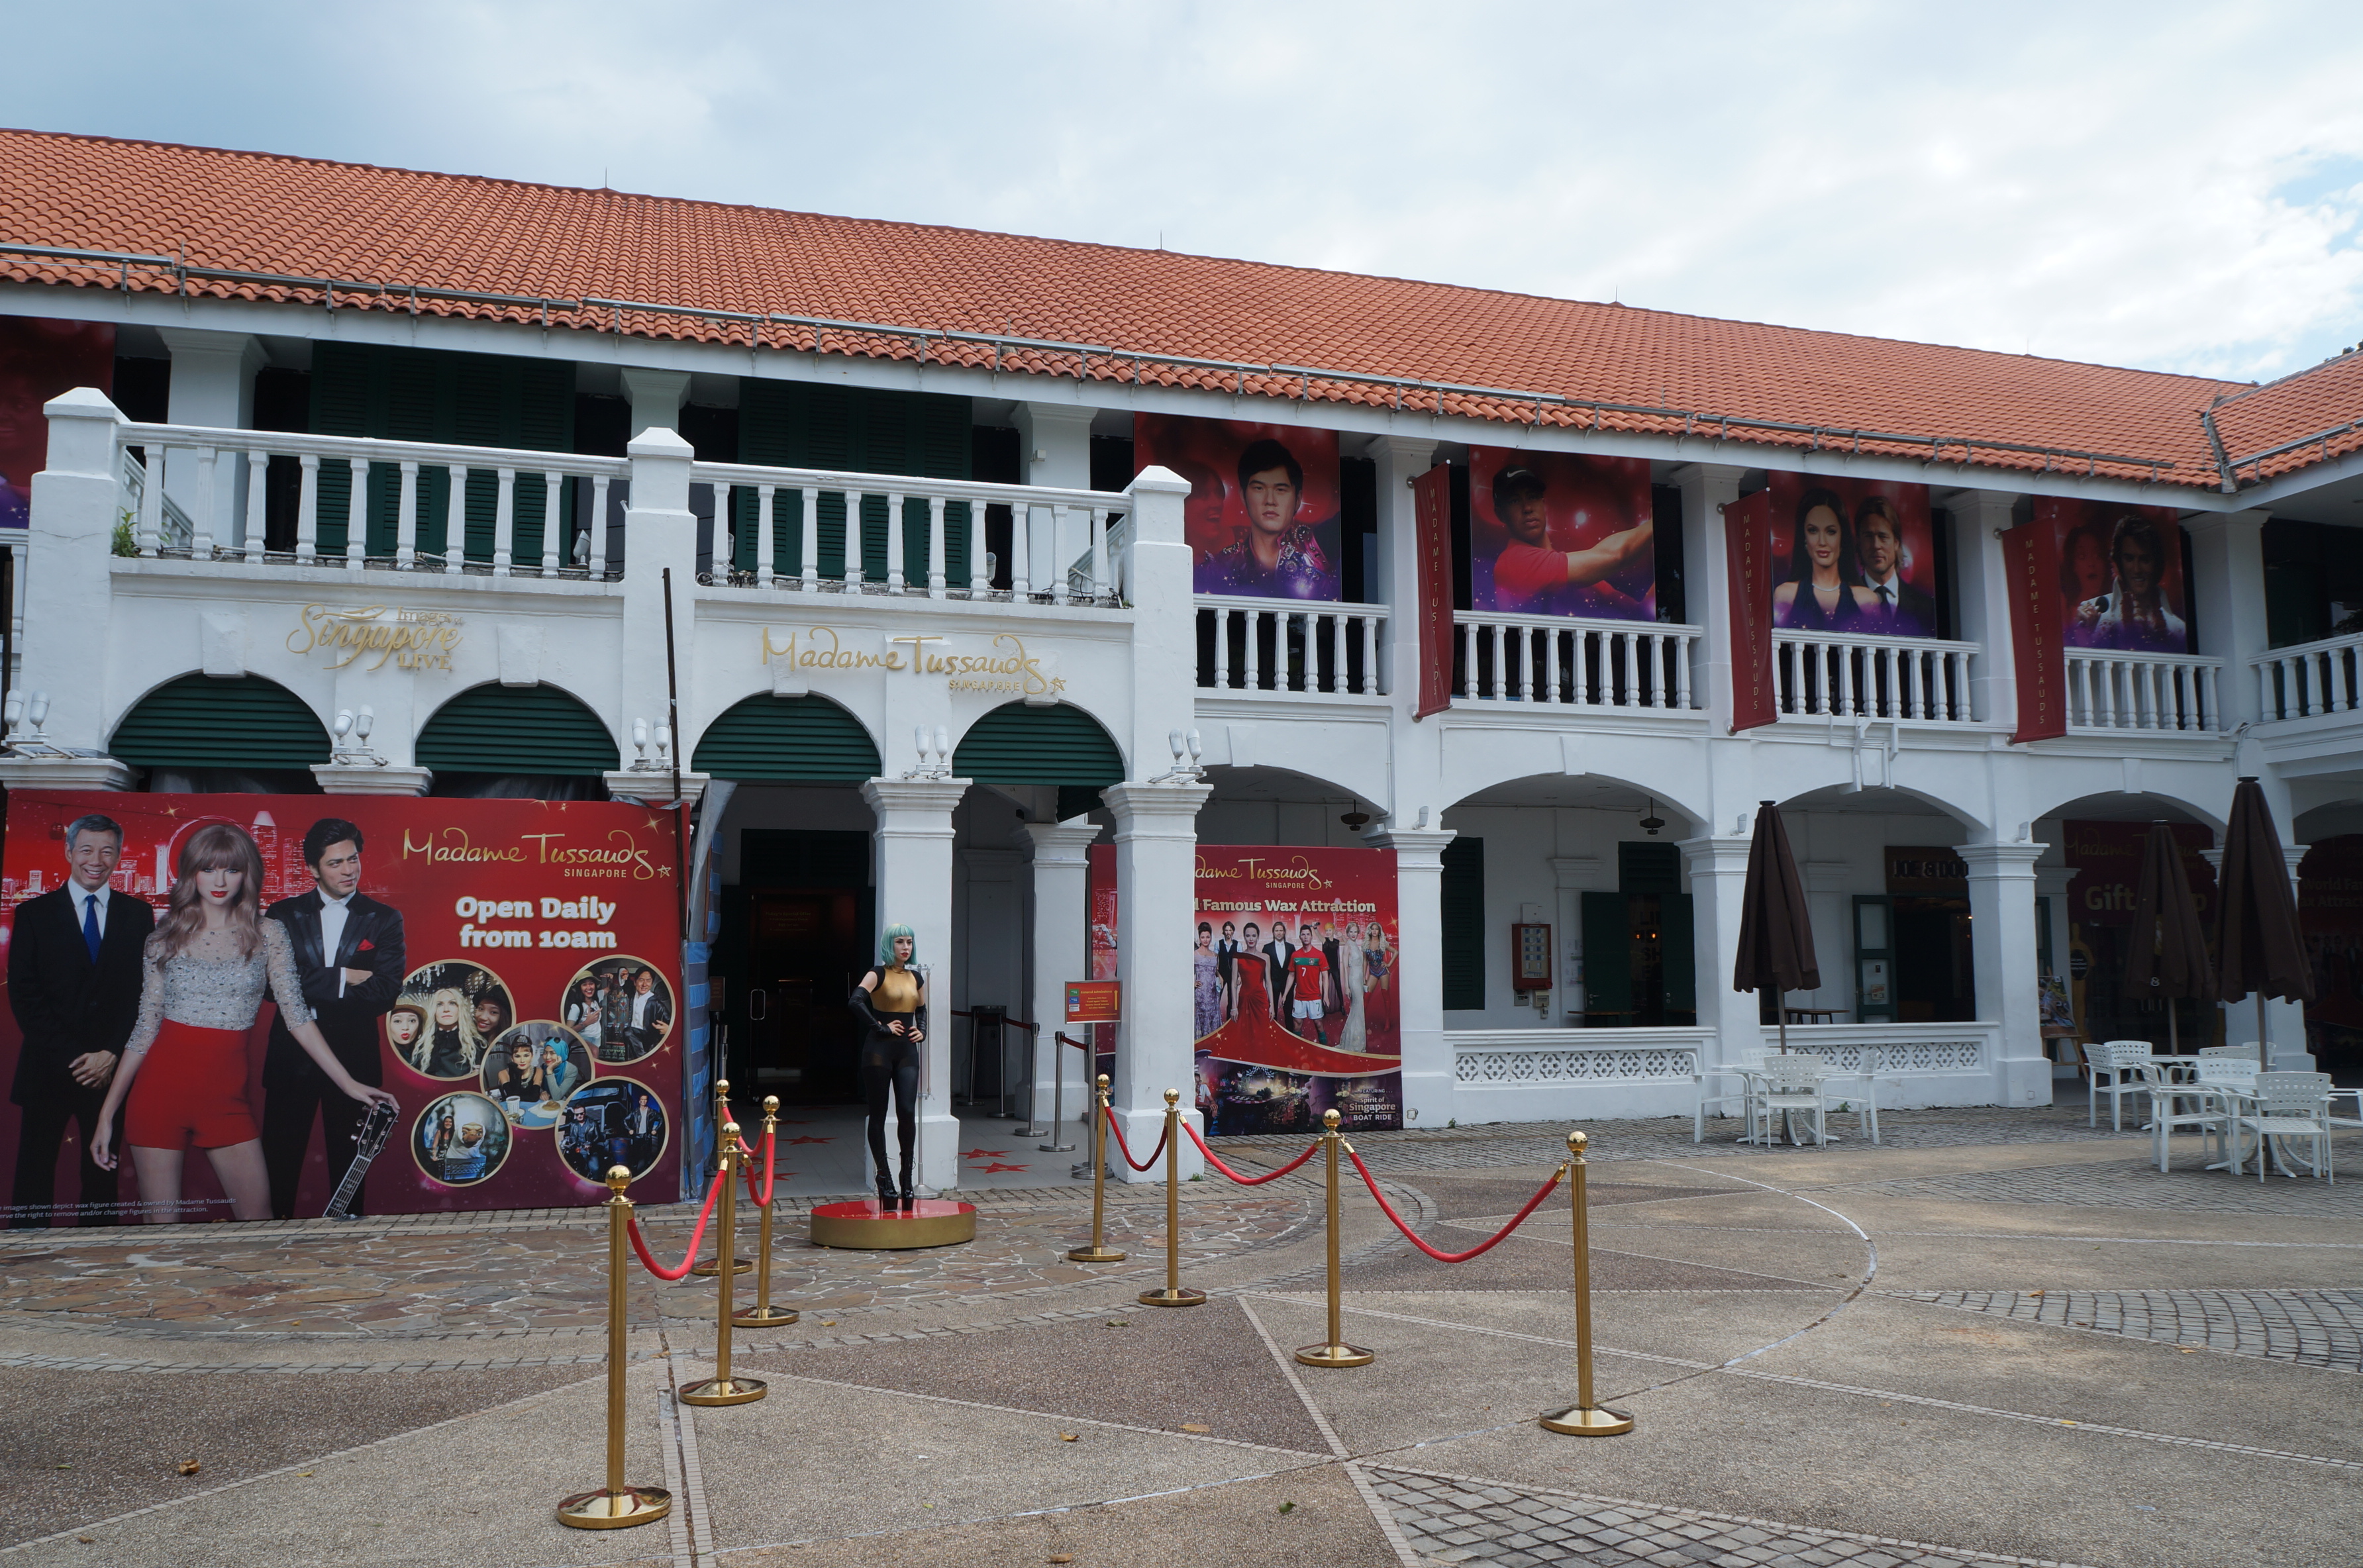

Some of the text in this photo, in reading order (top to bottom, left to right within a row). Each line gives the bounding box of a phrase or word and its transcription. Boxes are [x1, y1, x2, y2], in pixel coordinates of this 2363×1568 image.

[1430, 488, 1439, 571] MADAME
[395, 606, 452, 626] Images
[1743, 514, 1759, 710] MADAME TUSSAUDS
[285, 603, 464, 671] Singapore
[2025, 539, 2045, 724] MADAME TUSSAUDS
[397, 652, 453, 670] LIVE
[762, 626, 1048, 695] Madame Tussauds
[949, 679, 1021, 692] SINGAPORE
[403, 827, 655, 881] Madame Tussauds
[564, 868, 627, 879] SINGAPORE
[1195, 854, 1323, 890] dame Tussauds
[455, 895, 617, 926] Open Daily
[1202, 898, 1262, 912] Famous
[1264, 899, 1297, 912] Wax
[1301, 899, 1376, 912] Attraction
[2085, 883, 2137, 911] Gift
[459, 923, 618, 949] from 10am
[1301, 967, 1307, 977] 7
[1316, 1002, 1320, 1012] 7
[1349, 1102, 1396, 1113] Singapore
